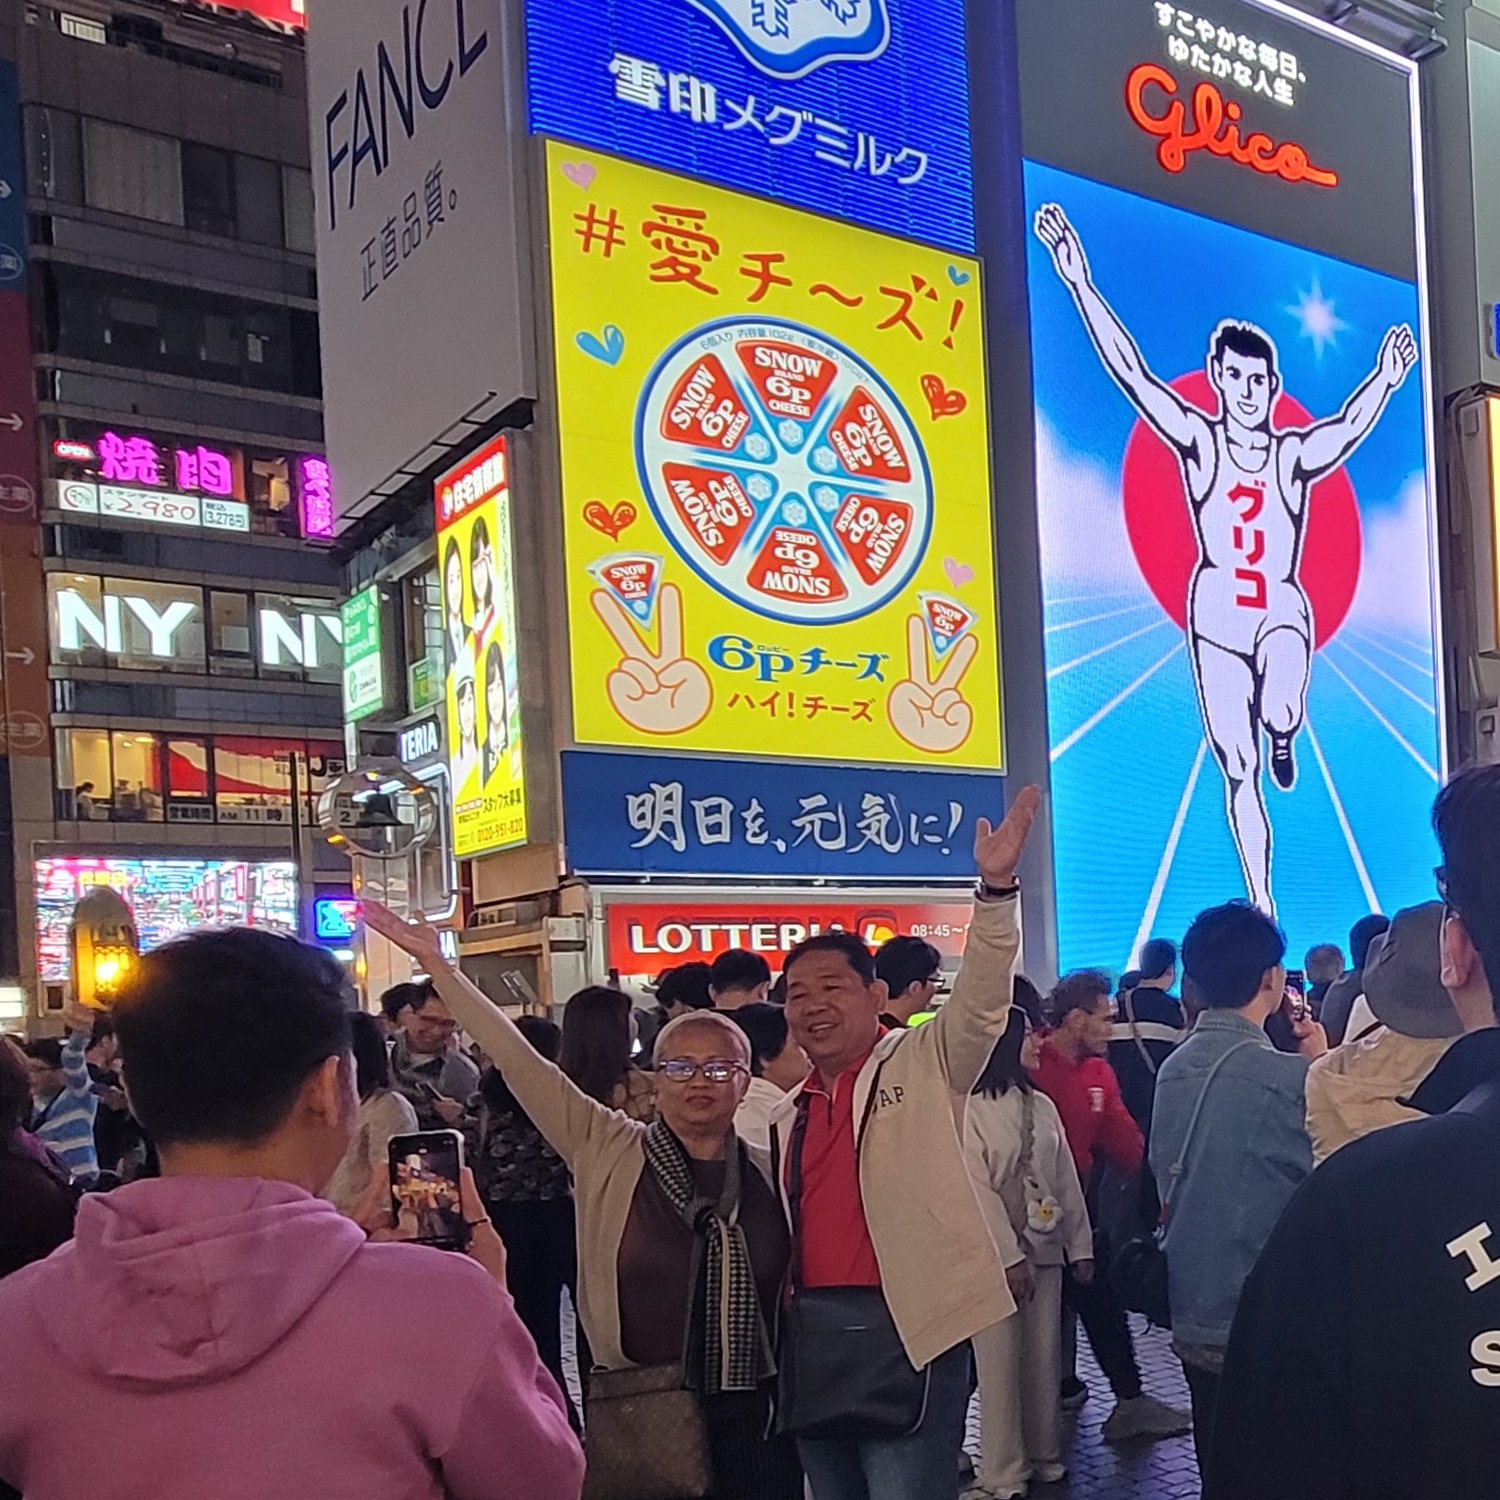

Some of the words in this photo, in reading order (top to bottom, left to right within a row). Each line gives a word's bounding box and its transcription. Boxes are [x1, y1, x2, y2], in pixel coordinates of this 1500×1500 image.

[1167, 32, 1294, 106] ゆたかな人生
[325, 0, 488, 231] FANCL
[608, 52, 928, 185] 雪印メグミルク
[1125, 63, 1339, 188] Glico
[360, 158, 458, 302] 正直品質。
[754, 346, 822, 378] SNOW
[670, 363, 717, 431] SNOW
[721, 410, 749, 449] CHEESE
[768, 399, 811, 418] CHEESE
[96, 430, 234, 496] 焼肉
[832, 430, 858, 471] CHEESE
[858, 403, 905, 470] SNOW
[670, 479, 725, 548] SNOW
[722, 475, 754, 518] CHEESE
[836, 496, 860, 533] CHEESE
[775, 530, 818, 546] CHEESE
[865, 512, 906, 576] SNOW
[1227, 480, 1268, 611] グリコ
[610, 564, 648, 579] SNOW
[762, 571, 831, 597] SNOW
[56, 590, 197, 658] NY
[625, 781, 965, 855] 明日を、元気に!
